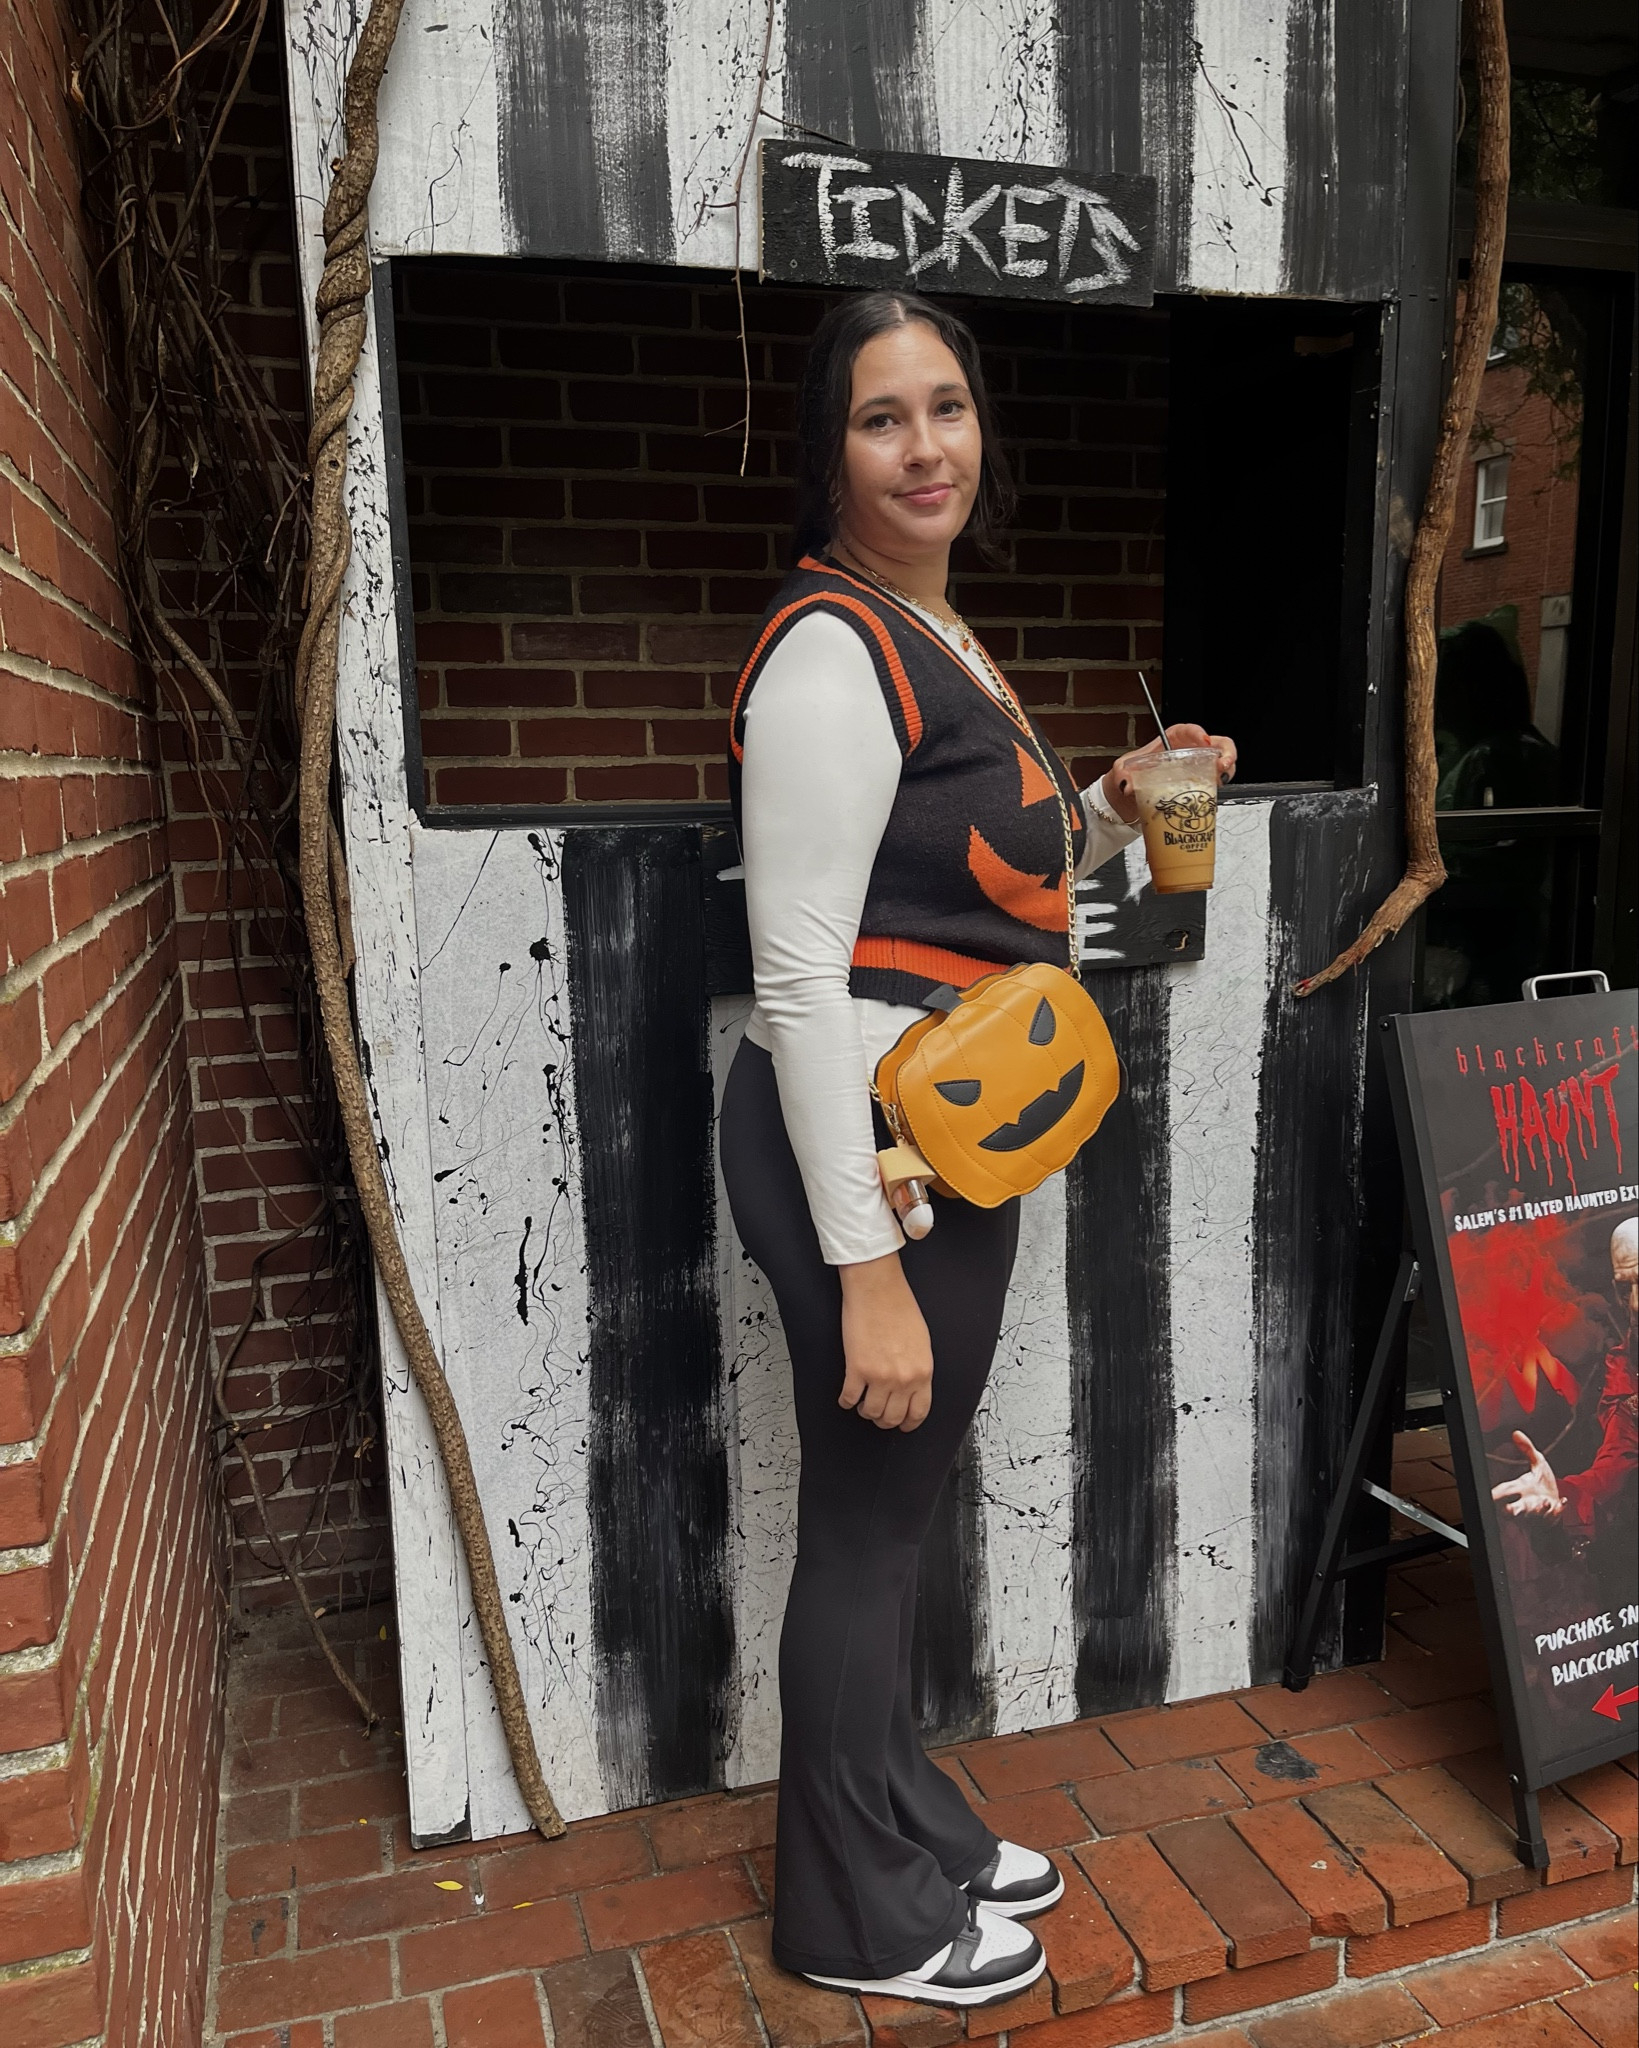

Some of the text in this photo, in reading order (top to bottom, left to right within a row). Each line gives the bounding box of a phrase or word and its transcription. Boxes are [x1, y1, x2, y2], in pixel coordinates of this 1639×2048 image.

[1490, 1063, 1622, 1196] HAUNT
[1508, 1205, 1523, 1221] #1
[1523, 1199, 1563, 1220] RATED
[1564, 1189, 1618, 1212] HAUNTED
[1535, 1612, 1614, 1655] PURCHASE
[1551, 1640, 1638, 1686] BLACKCRAFT
